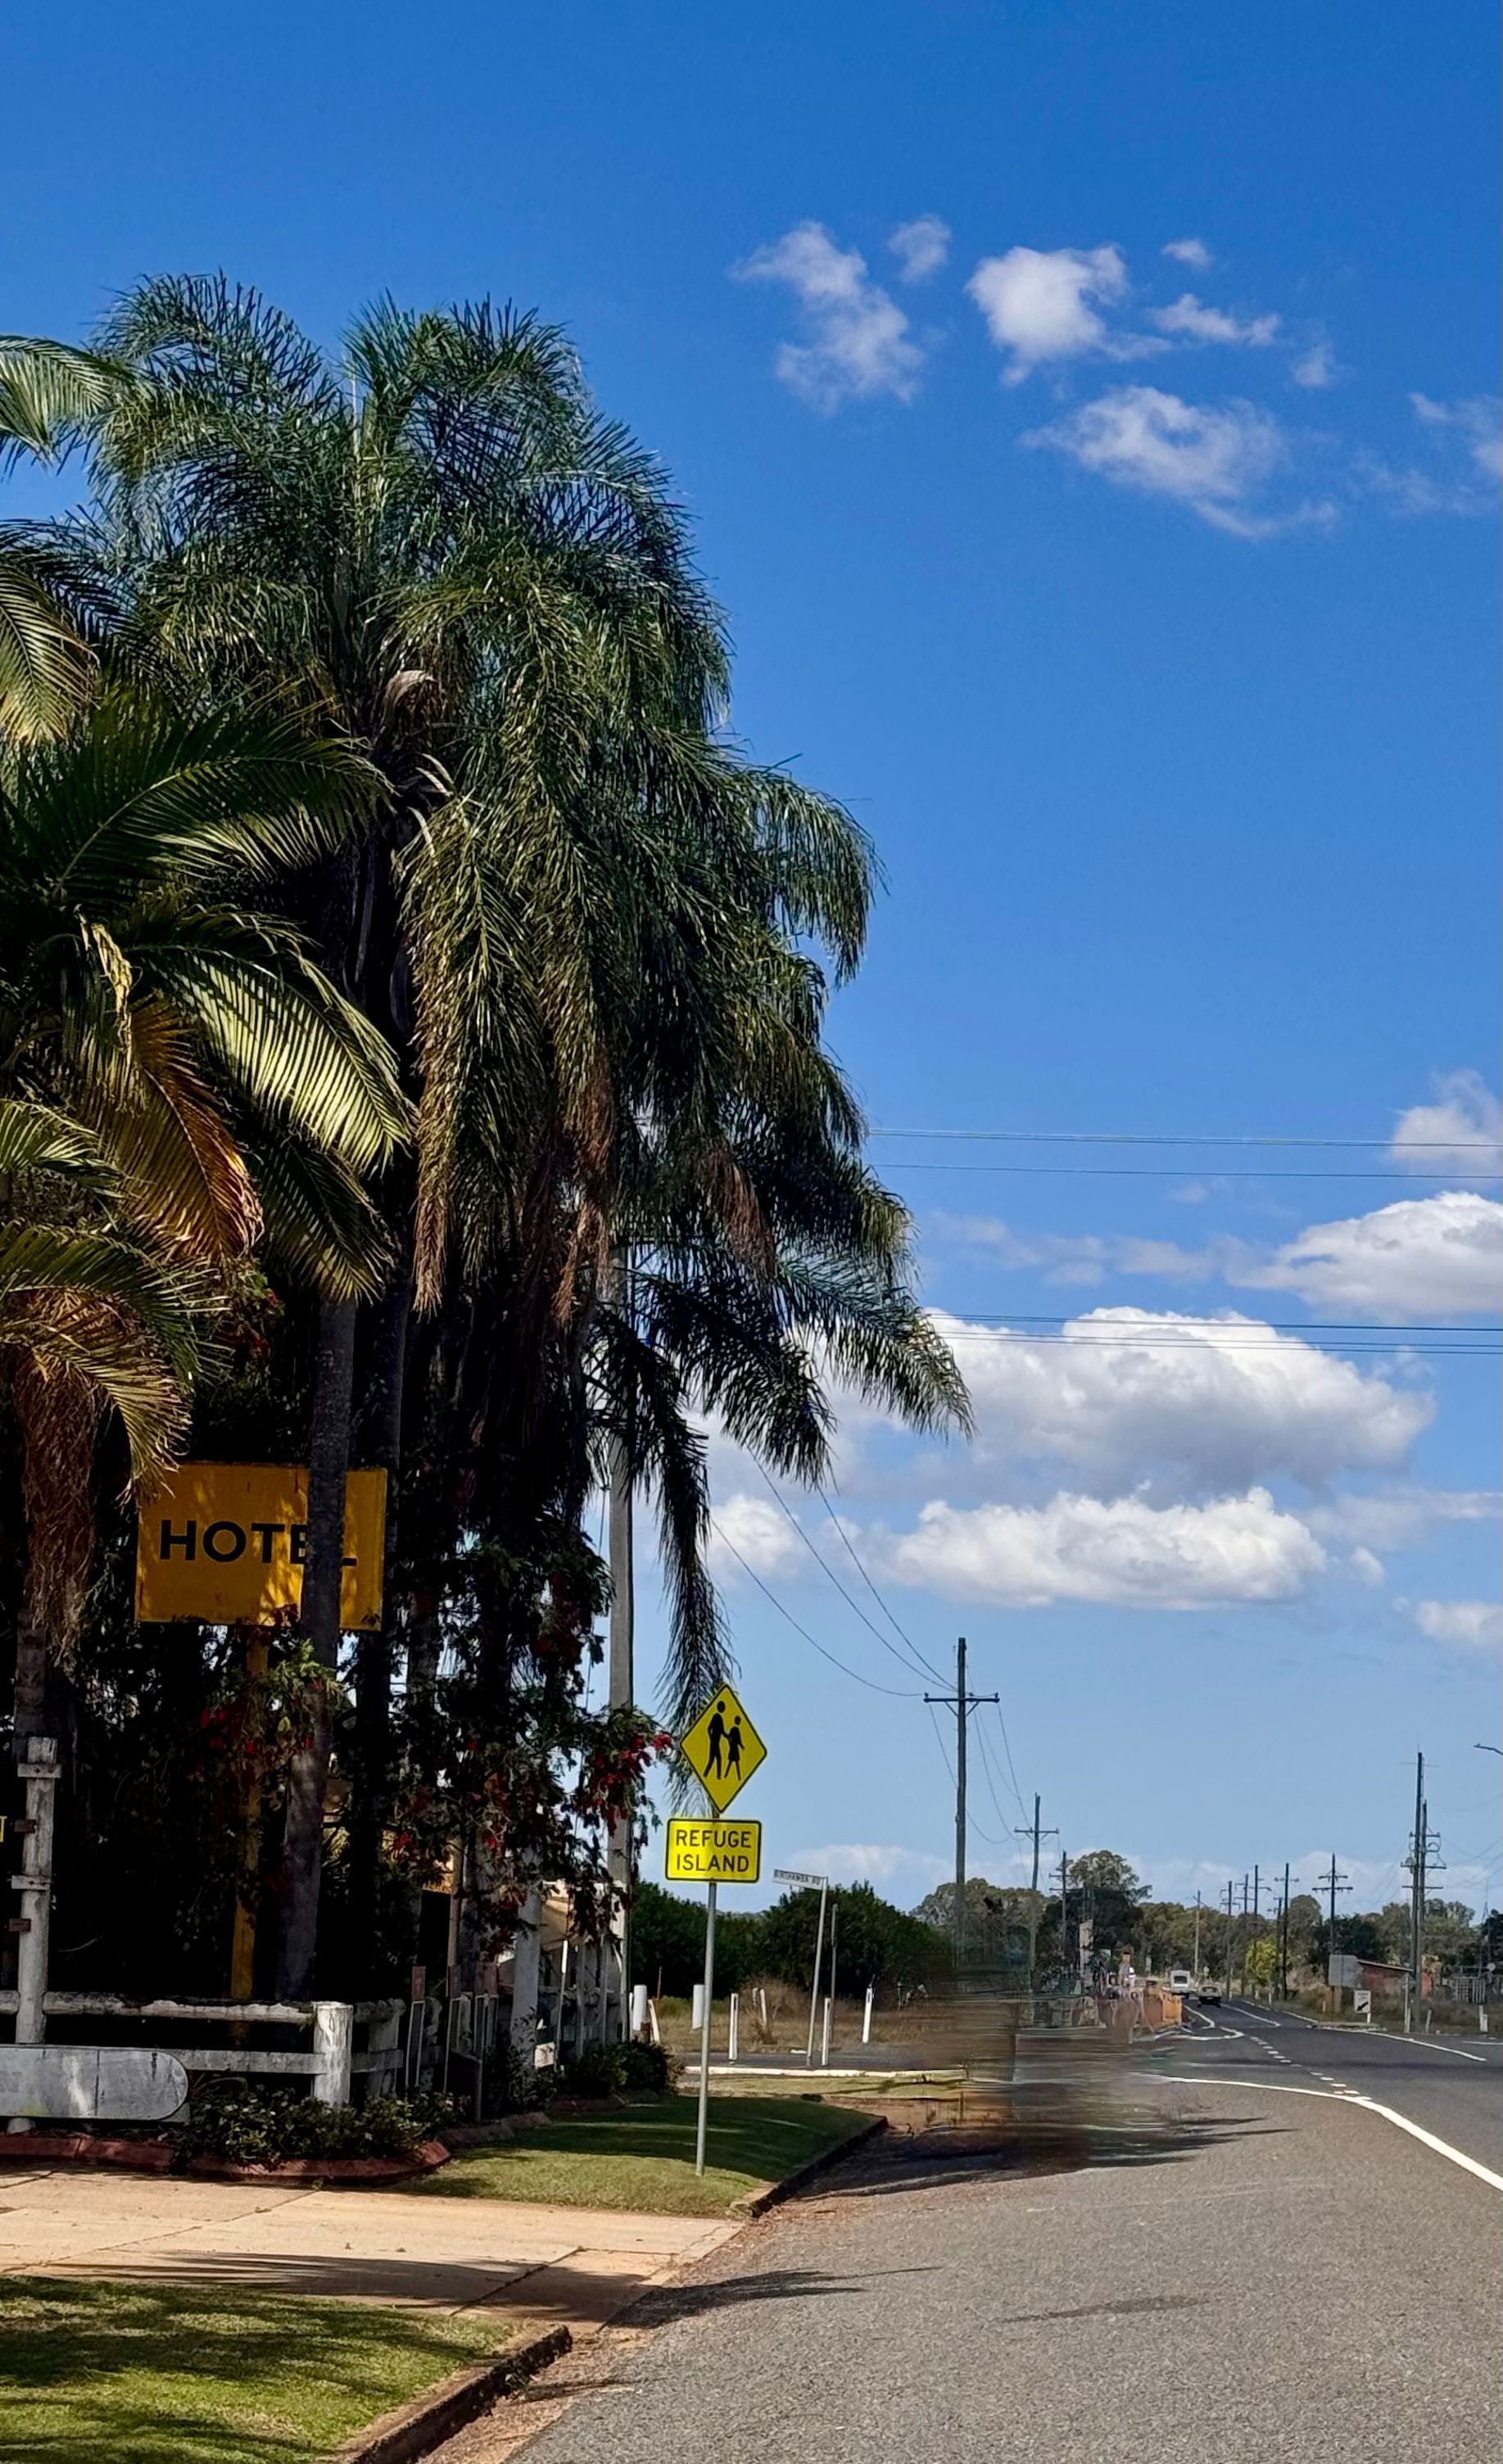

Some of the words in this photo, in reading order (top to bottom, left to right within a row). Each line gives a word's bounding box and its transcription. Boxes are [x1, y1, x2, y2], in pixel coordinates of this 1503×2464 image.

[160, 1520, 357, 1567] HOTE
[676, 1829, 752, 1849] REFUGE
[677, 1854, 749, 1873] ISLAND
